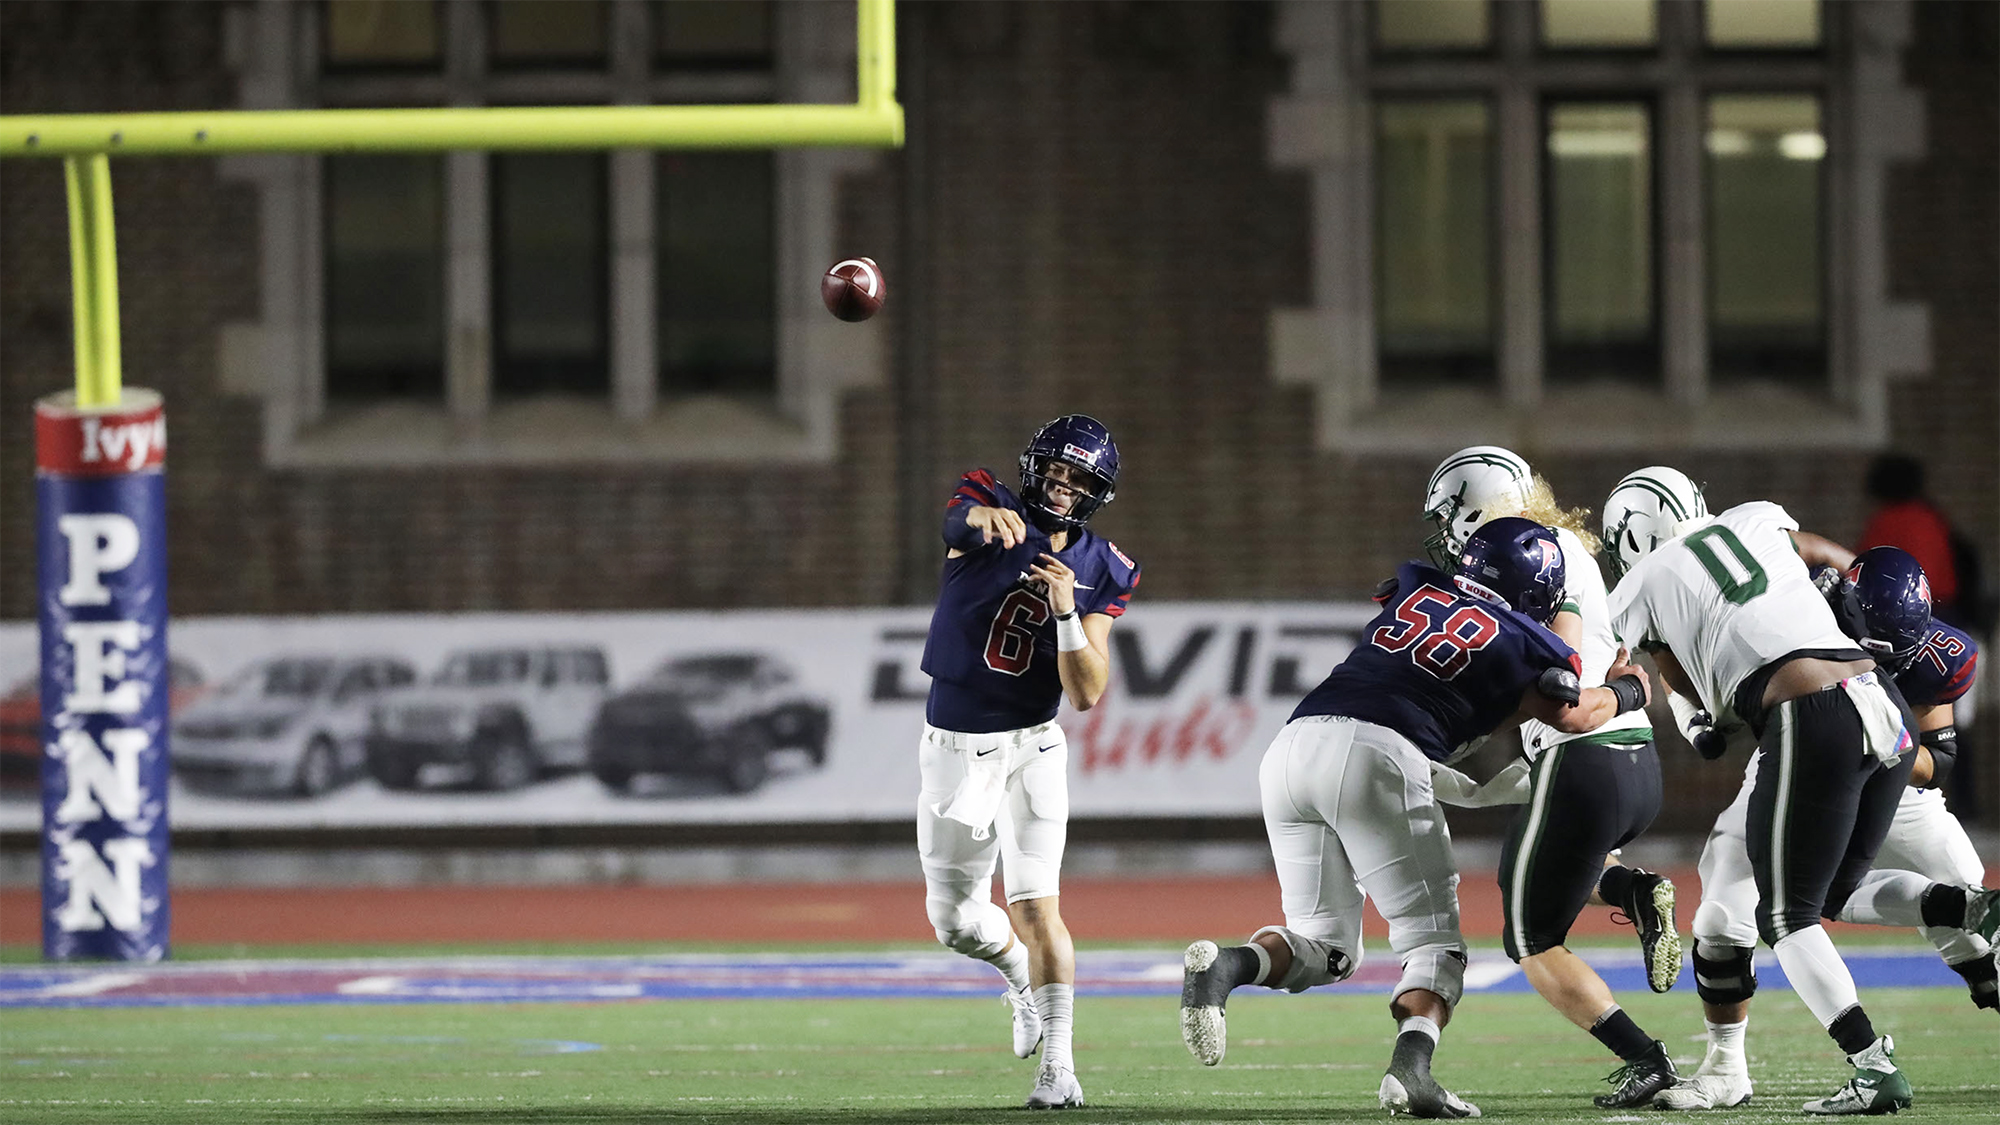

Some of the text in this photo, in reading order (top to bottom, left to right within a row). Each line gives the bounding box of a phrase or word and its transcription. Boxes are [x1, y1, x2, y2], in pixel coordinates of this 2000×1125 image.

[983, 588, 1050, 676] 6
[1371, 583, 1500, 681] 58
[1916, 630, 1966, 676] 75
[57, 513, 150, 932] PENN
